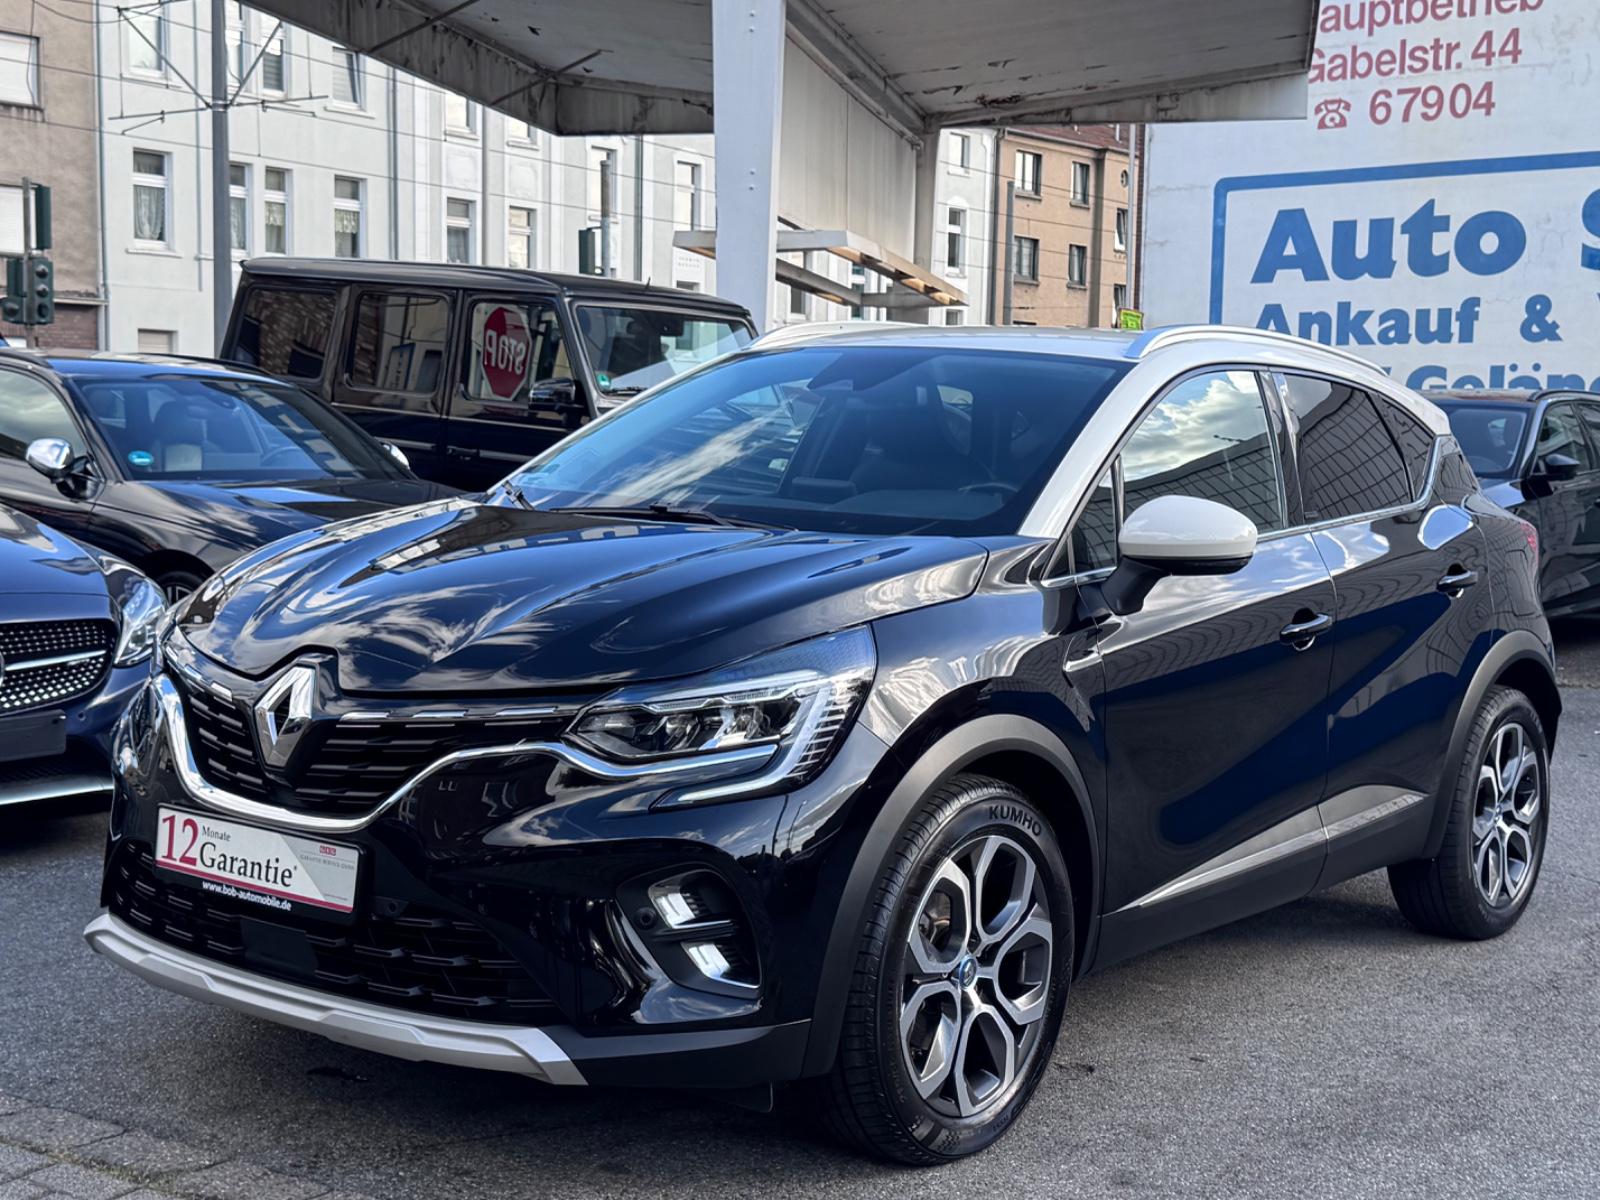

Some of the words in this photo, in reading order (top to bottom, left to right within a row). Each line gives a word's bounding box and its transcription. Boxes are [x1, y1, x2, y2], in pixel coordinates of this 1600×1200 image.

[1471, 27, 1522, 67] 44
[1250, 198, 1527, 284] Auto
[1255, 297, 1481, 346] Ankauf
[1519, 294, 1563, 343] &
[161, 814, 199, 867] 12
[201, 825, 231, 842] Monate
[988, 804, 1042, 837] KUMHO
[199, 841, 293, 888] Garantie
[202, 880, 292, 911] www.bob-automobile.de
